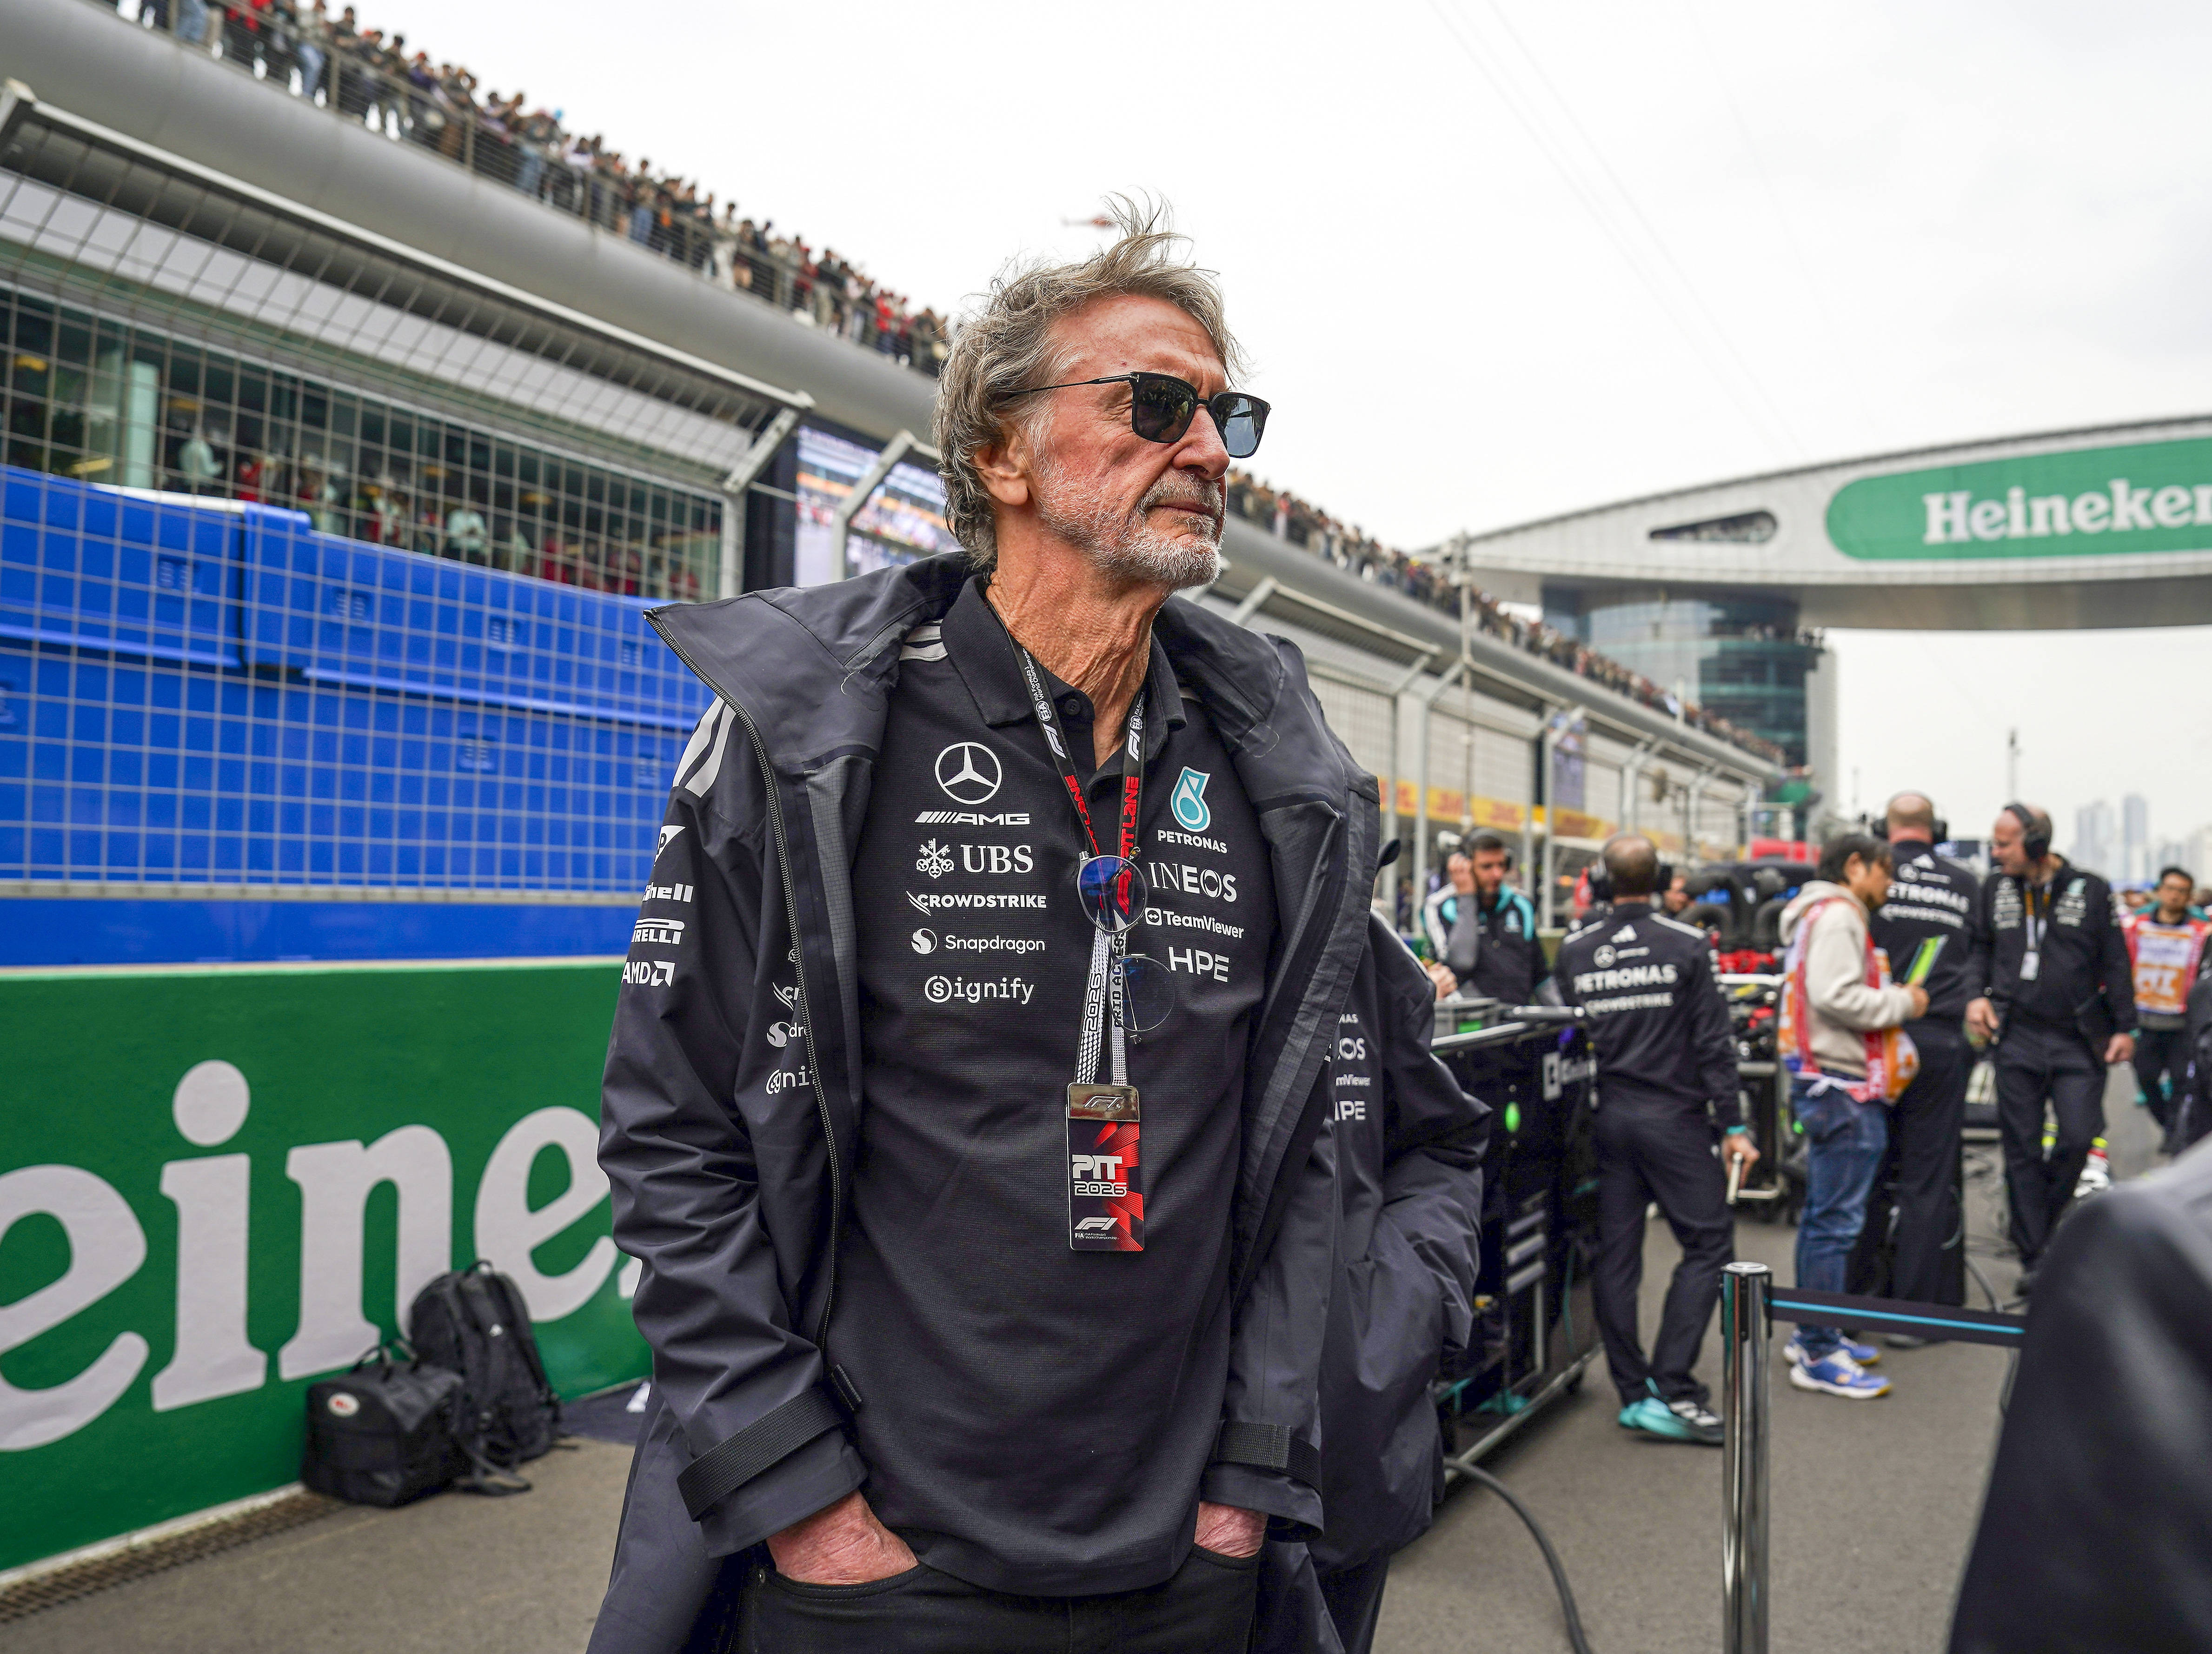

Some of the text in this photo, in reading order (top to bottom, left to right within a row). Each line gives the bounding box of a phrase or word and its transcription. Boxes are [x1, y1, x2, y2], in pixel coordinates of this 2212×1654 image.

[954, 812, 1030, 826] AMG
[1157, 830, 1228, 854] PETRONAS
[961, 844, 1034, 874] UBS
[643, 882, 694, 903] hell
[1148, 862, 1237, 903] INEOS
[917, 894, 1047, 909] CROWDSTRIKE
[1163, 910, 1244, 939] TeamViewer
[945, 935, 1045, 954] Snapdragon
[622, 961, 651, 984] AMD
[1168, 946, 1229, 983] HPE
[924, 975, 1034, 1005] signify
[1085, 973, 1102, 1031] 2026
[1072, 1154, 1122, 1180] PIT
[1075, 1182, 1127, 1196] 2026
[0, 1059, 637, 1452] eine
